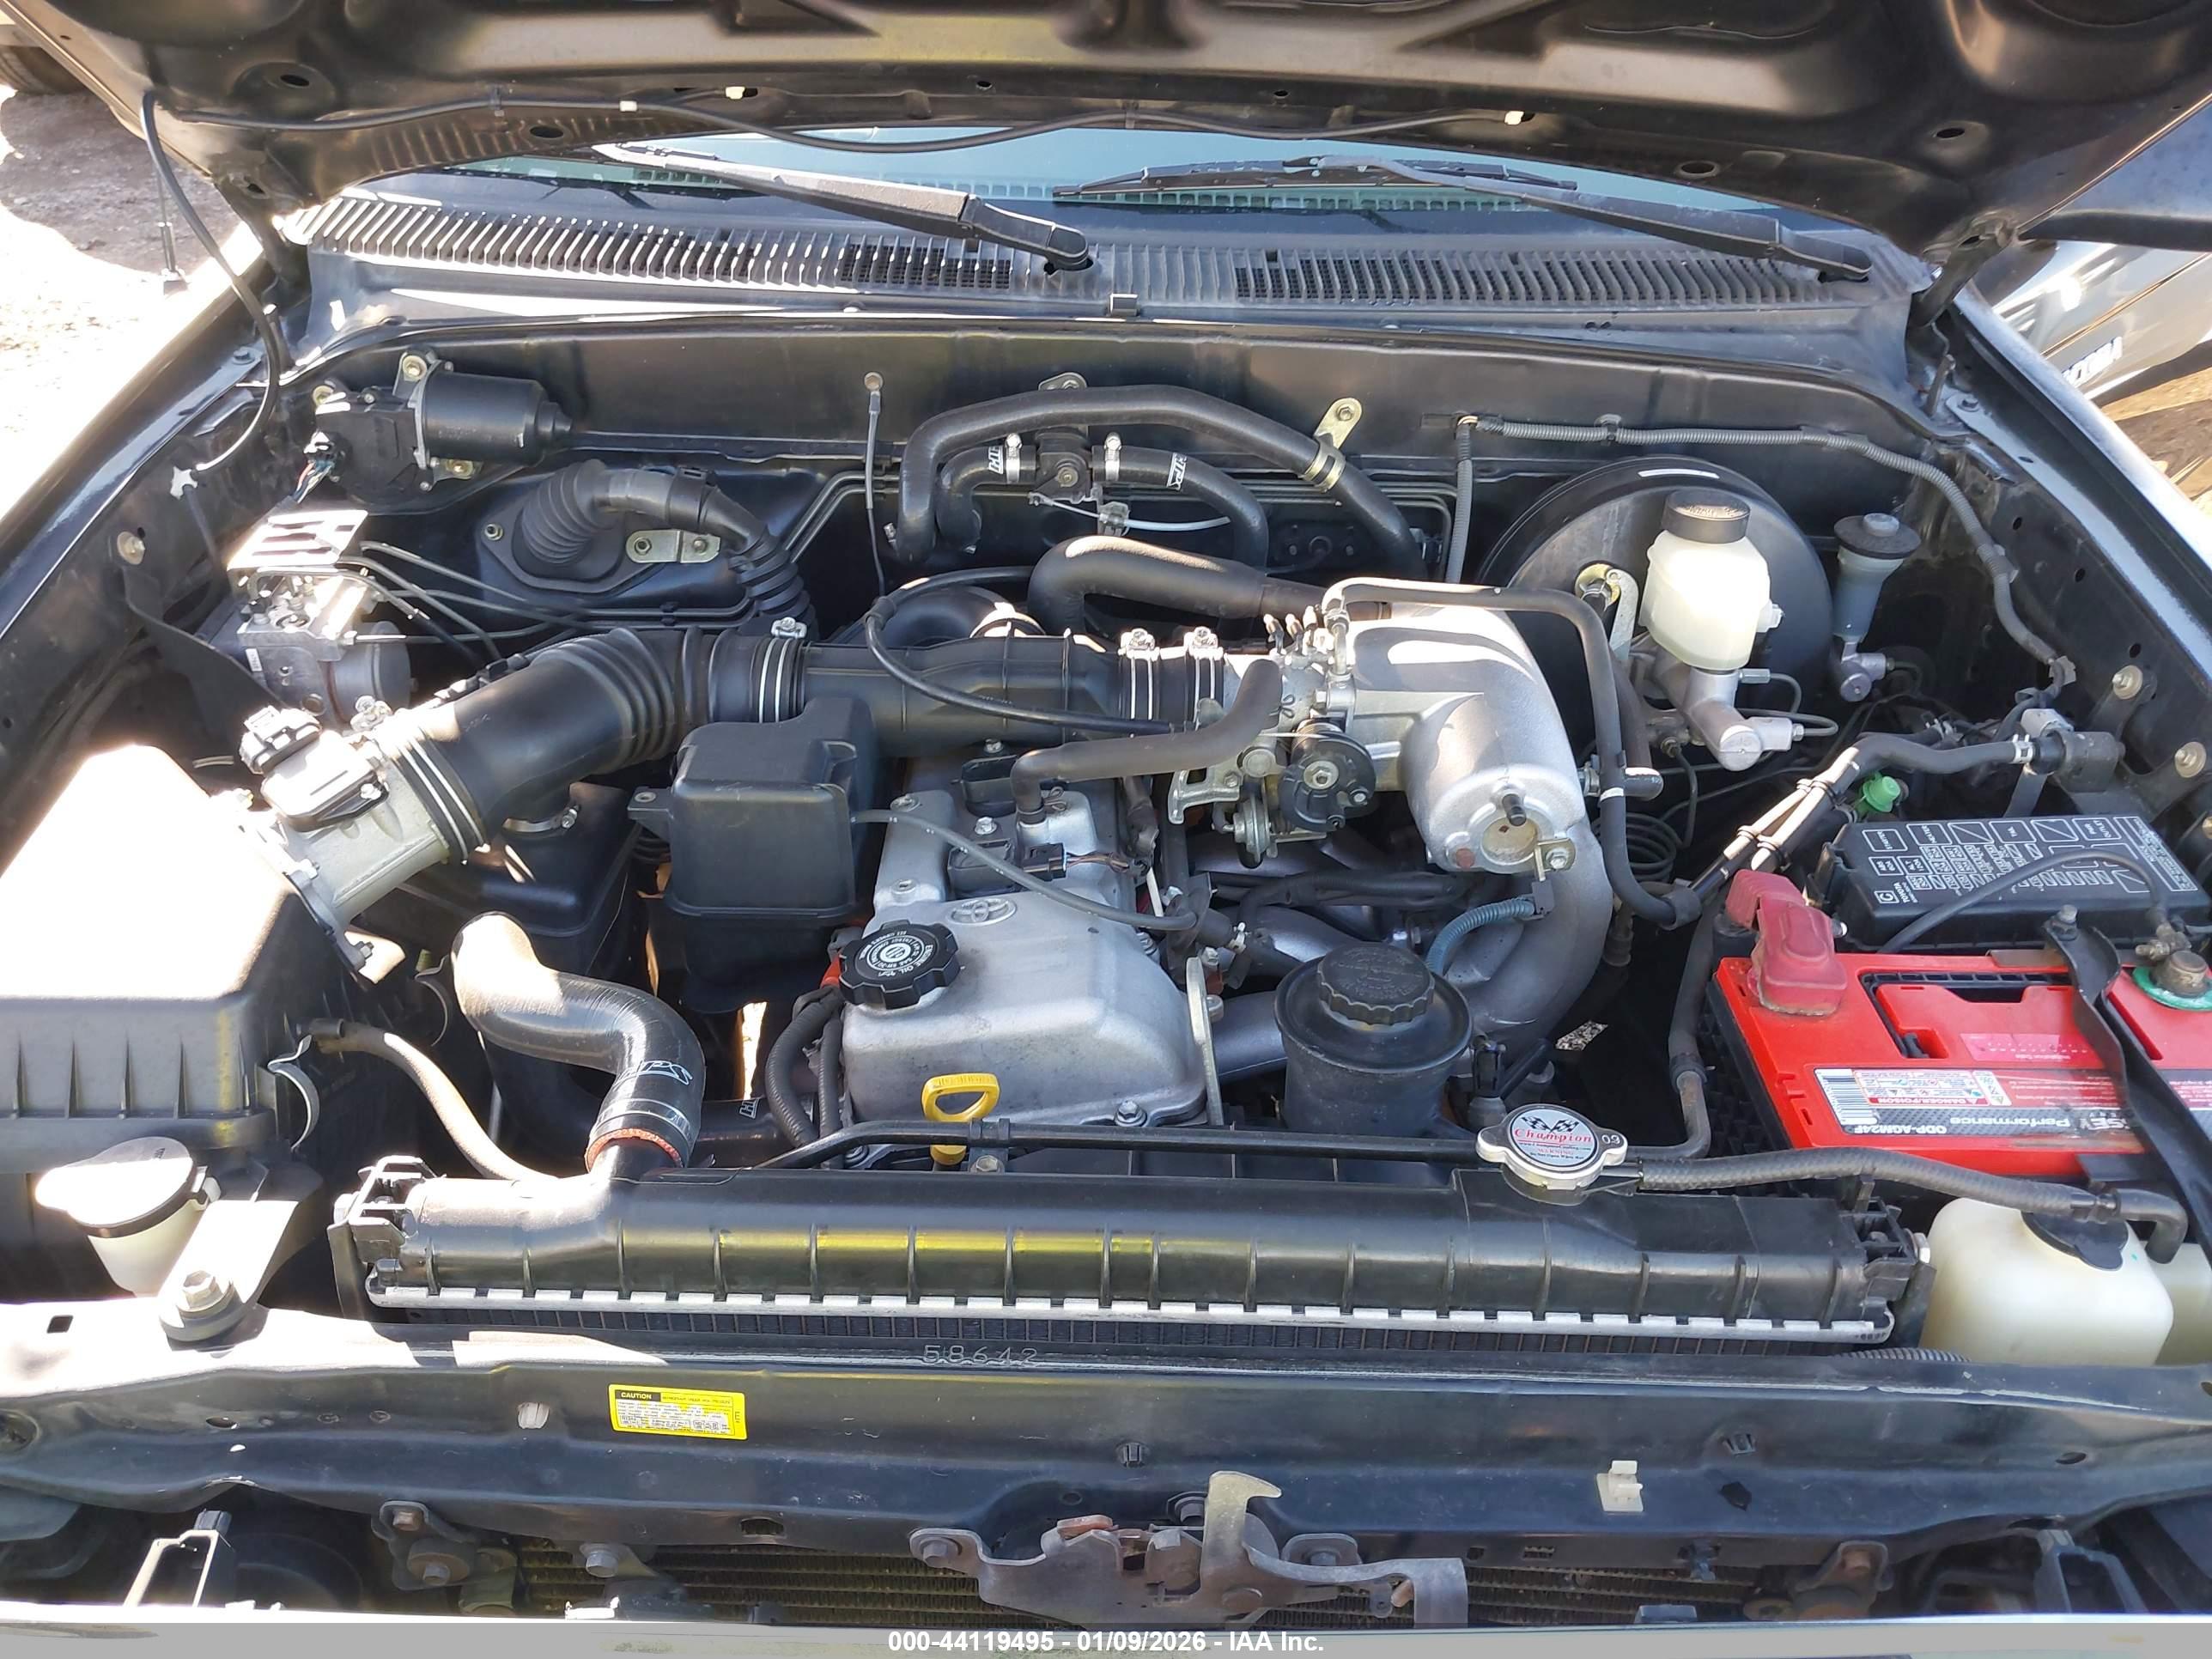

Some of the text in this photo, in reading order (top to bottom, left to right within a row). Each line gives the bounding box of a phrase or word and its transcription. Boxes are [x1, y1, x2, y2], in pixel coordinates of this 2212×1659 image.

[1877, 830, 1893, 850] STARTER
[1922, 824, 1937, 843] HEATER
[1893, 882, 1910, 903] TOYOTA
[898, 964, 914, 975] OIL
[1950, 1116, 2069, 1127] Performance
[1514, 1127, 1591, 1143] Champion
